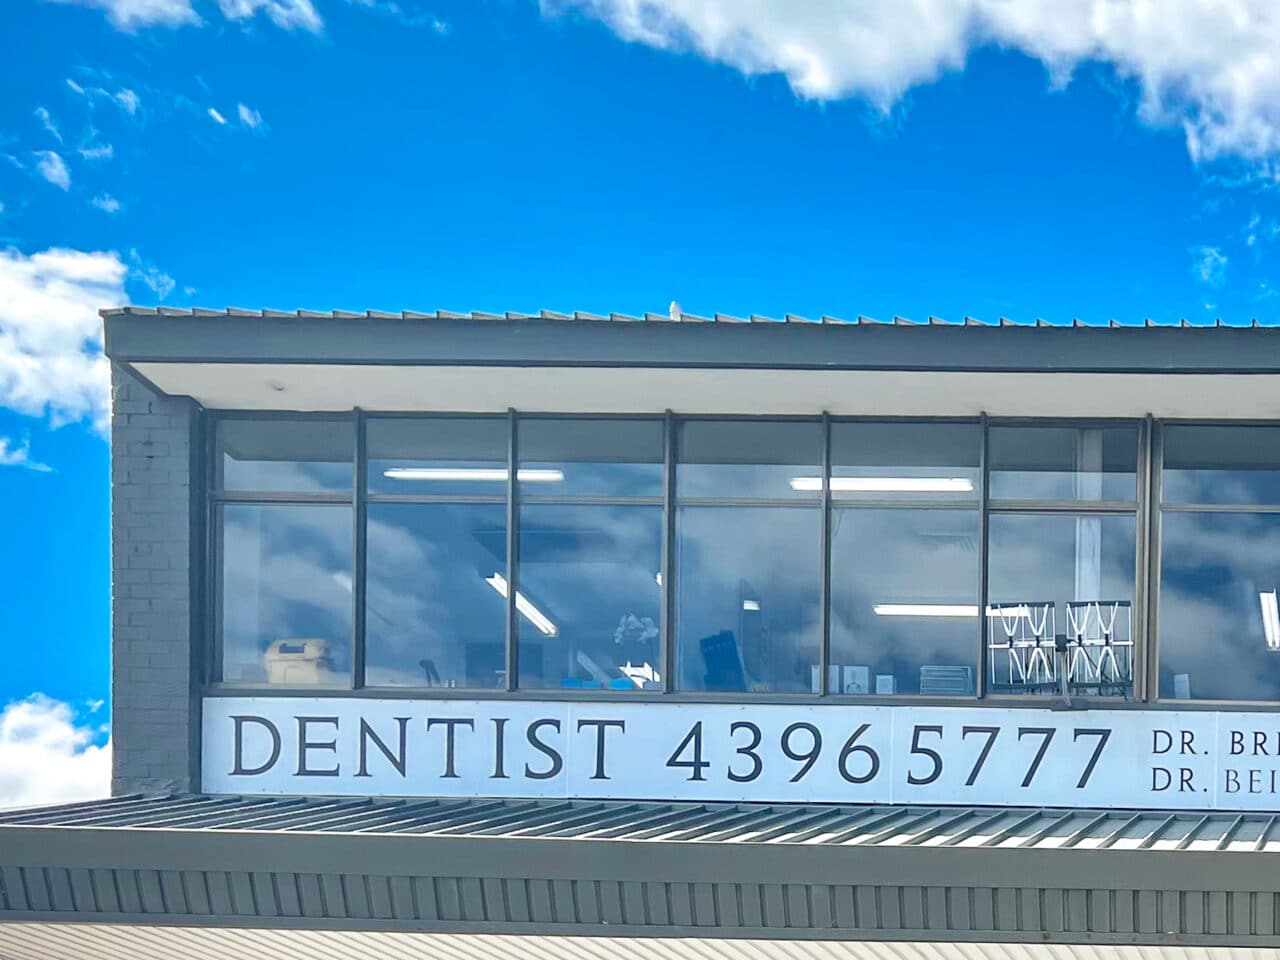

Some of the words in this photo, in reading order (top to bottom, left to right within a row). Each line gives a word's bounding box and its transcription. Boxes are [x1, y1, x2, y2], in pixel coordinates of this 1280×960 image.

[227, 714, 626, 780] DENTIST
[1151, 729, 1209, 756] DR.
[1150, 766, 1208, 793] DR.
[1224, 768, 1278, 794] BEI
